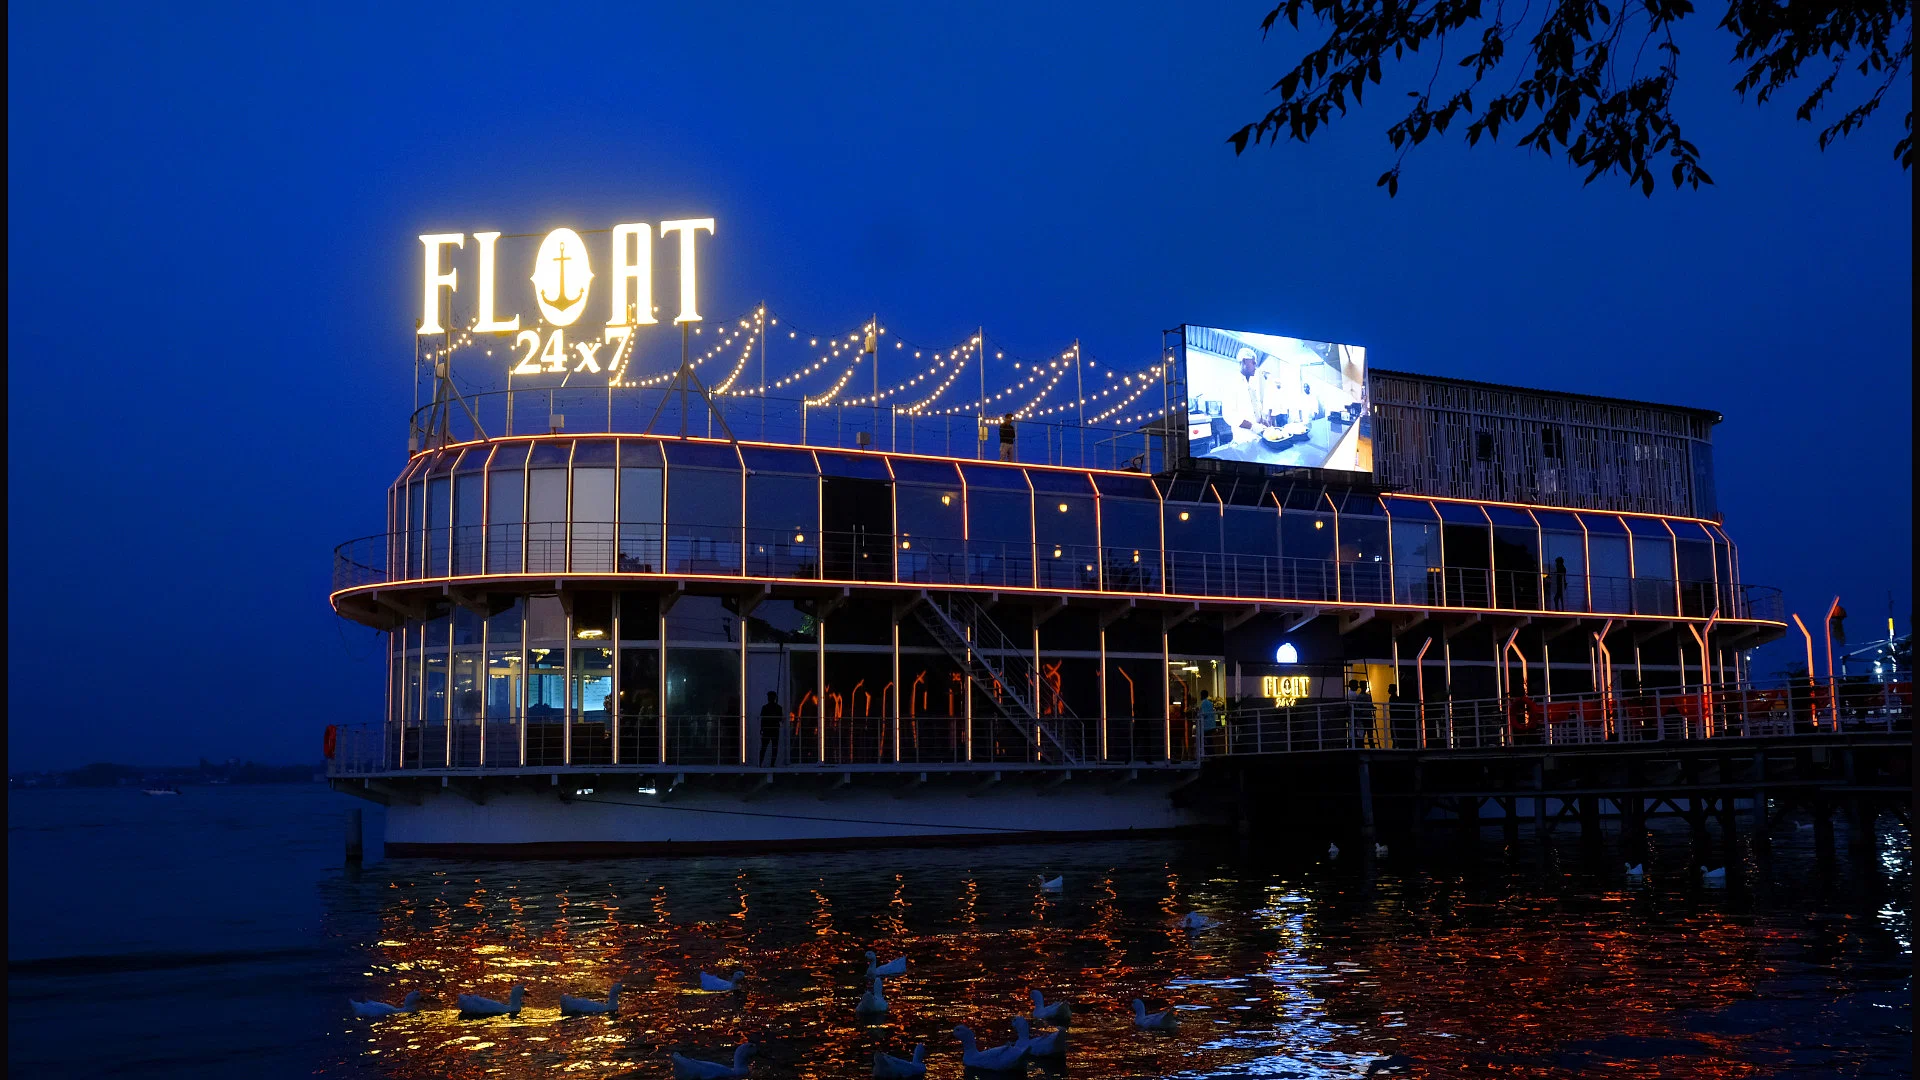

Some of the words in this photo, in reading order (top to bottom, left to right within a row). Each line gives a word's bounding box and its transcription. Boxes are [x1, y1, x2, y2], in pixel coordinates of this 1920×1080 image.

[417, 217, 715, 335] FLOAT
[513, 326, 632, 375] 24x7
[1262, 675, 1310, 698] FLOAT
